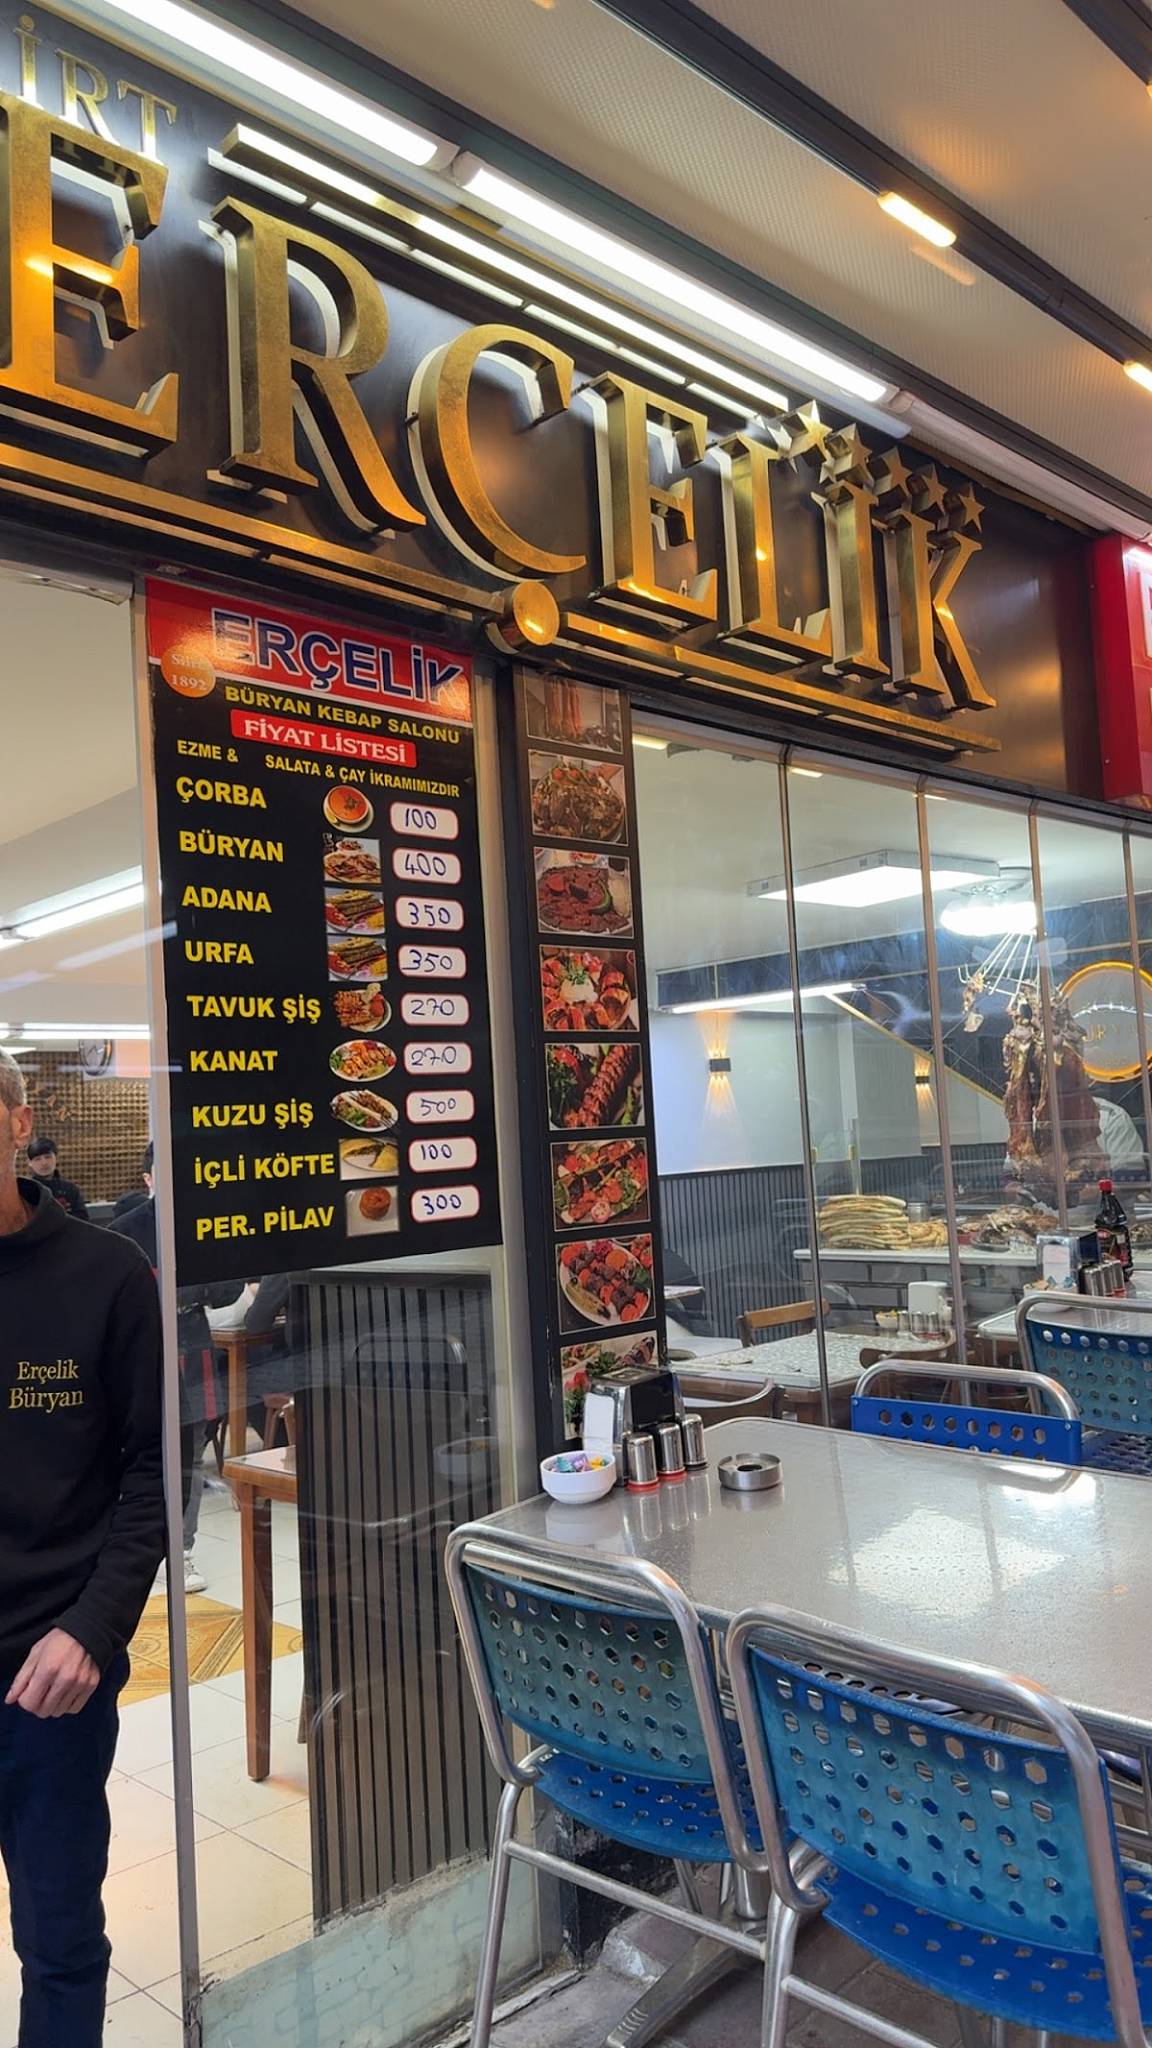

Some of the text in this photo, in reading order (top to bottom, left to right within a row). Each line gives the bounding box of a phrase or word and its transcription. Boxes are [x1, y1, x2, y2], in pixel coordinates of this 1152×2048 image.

[211, 608, 466, 711] ERÇELİK
[172, 674, 208, 691] 1892
[225, 685, 460, 745] BÜRYAN KEBAP SALONU
[244, 718, 406, 763] FİYAT LİSTESİ
[177, 739, 460, 798] EZME & SALATA & ÇAY İKRAMIMIZDIR
[176, 776, 267, 809] ÇORBA
[404, 808, 437, 831] 100
[179, 828, 284, 862] BÜRYAN
[404, 853, 447, 877] 400
[182, 885, 273, 913] ADANA
[408, 902, 451, 927] 350
[184, 940, 254, 965] URFA
[403, 949, 453, 973] 350
[186, 993, 322, 1024] TAVUK ŞİŞ
[411, 998, 456, 1017] 270
[190, 1050, 278, 1073] KANAT
[410, 1046, 457, 1067] 270
[192, 1098, 314, 1130] KUZU ŞİŞ
[420, 1098, 457, 1117] 500
[421, 1143, 453, 1161] 100
[194, 1152, 336, 1189] İÇLİ KÖFTE
[422, 1194, 462, 1216] 300
[196, 1205, 335, 1241] PER. PİLAV
[17, 1359, 80, 1384] Erçelik
[8, 1386, 84, 1413] Büryan
